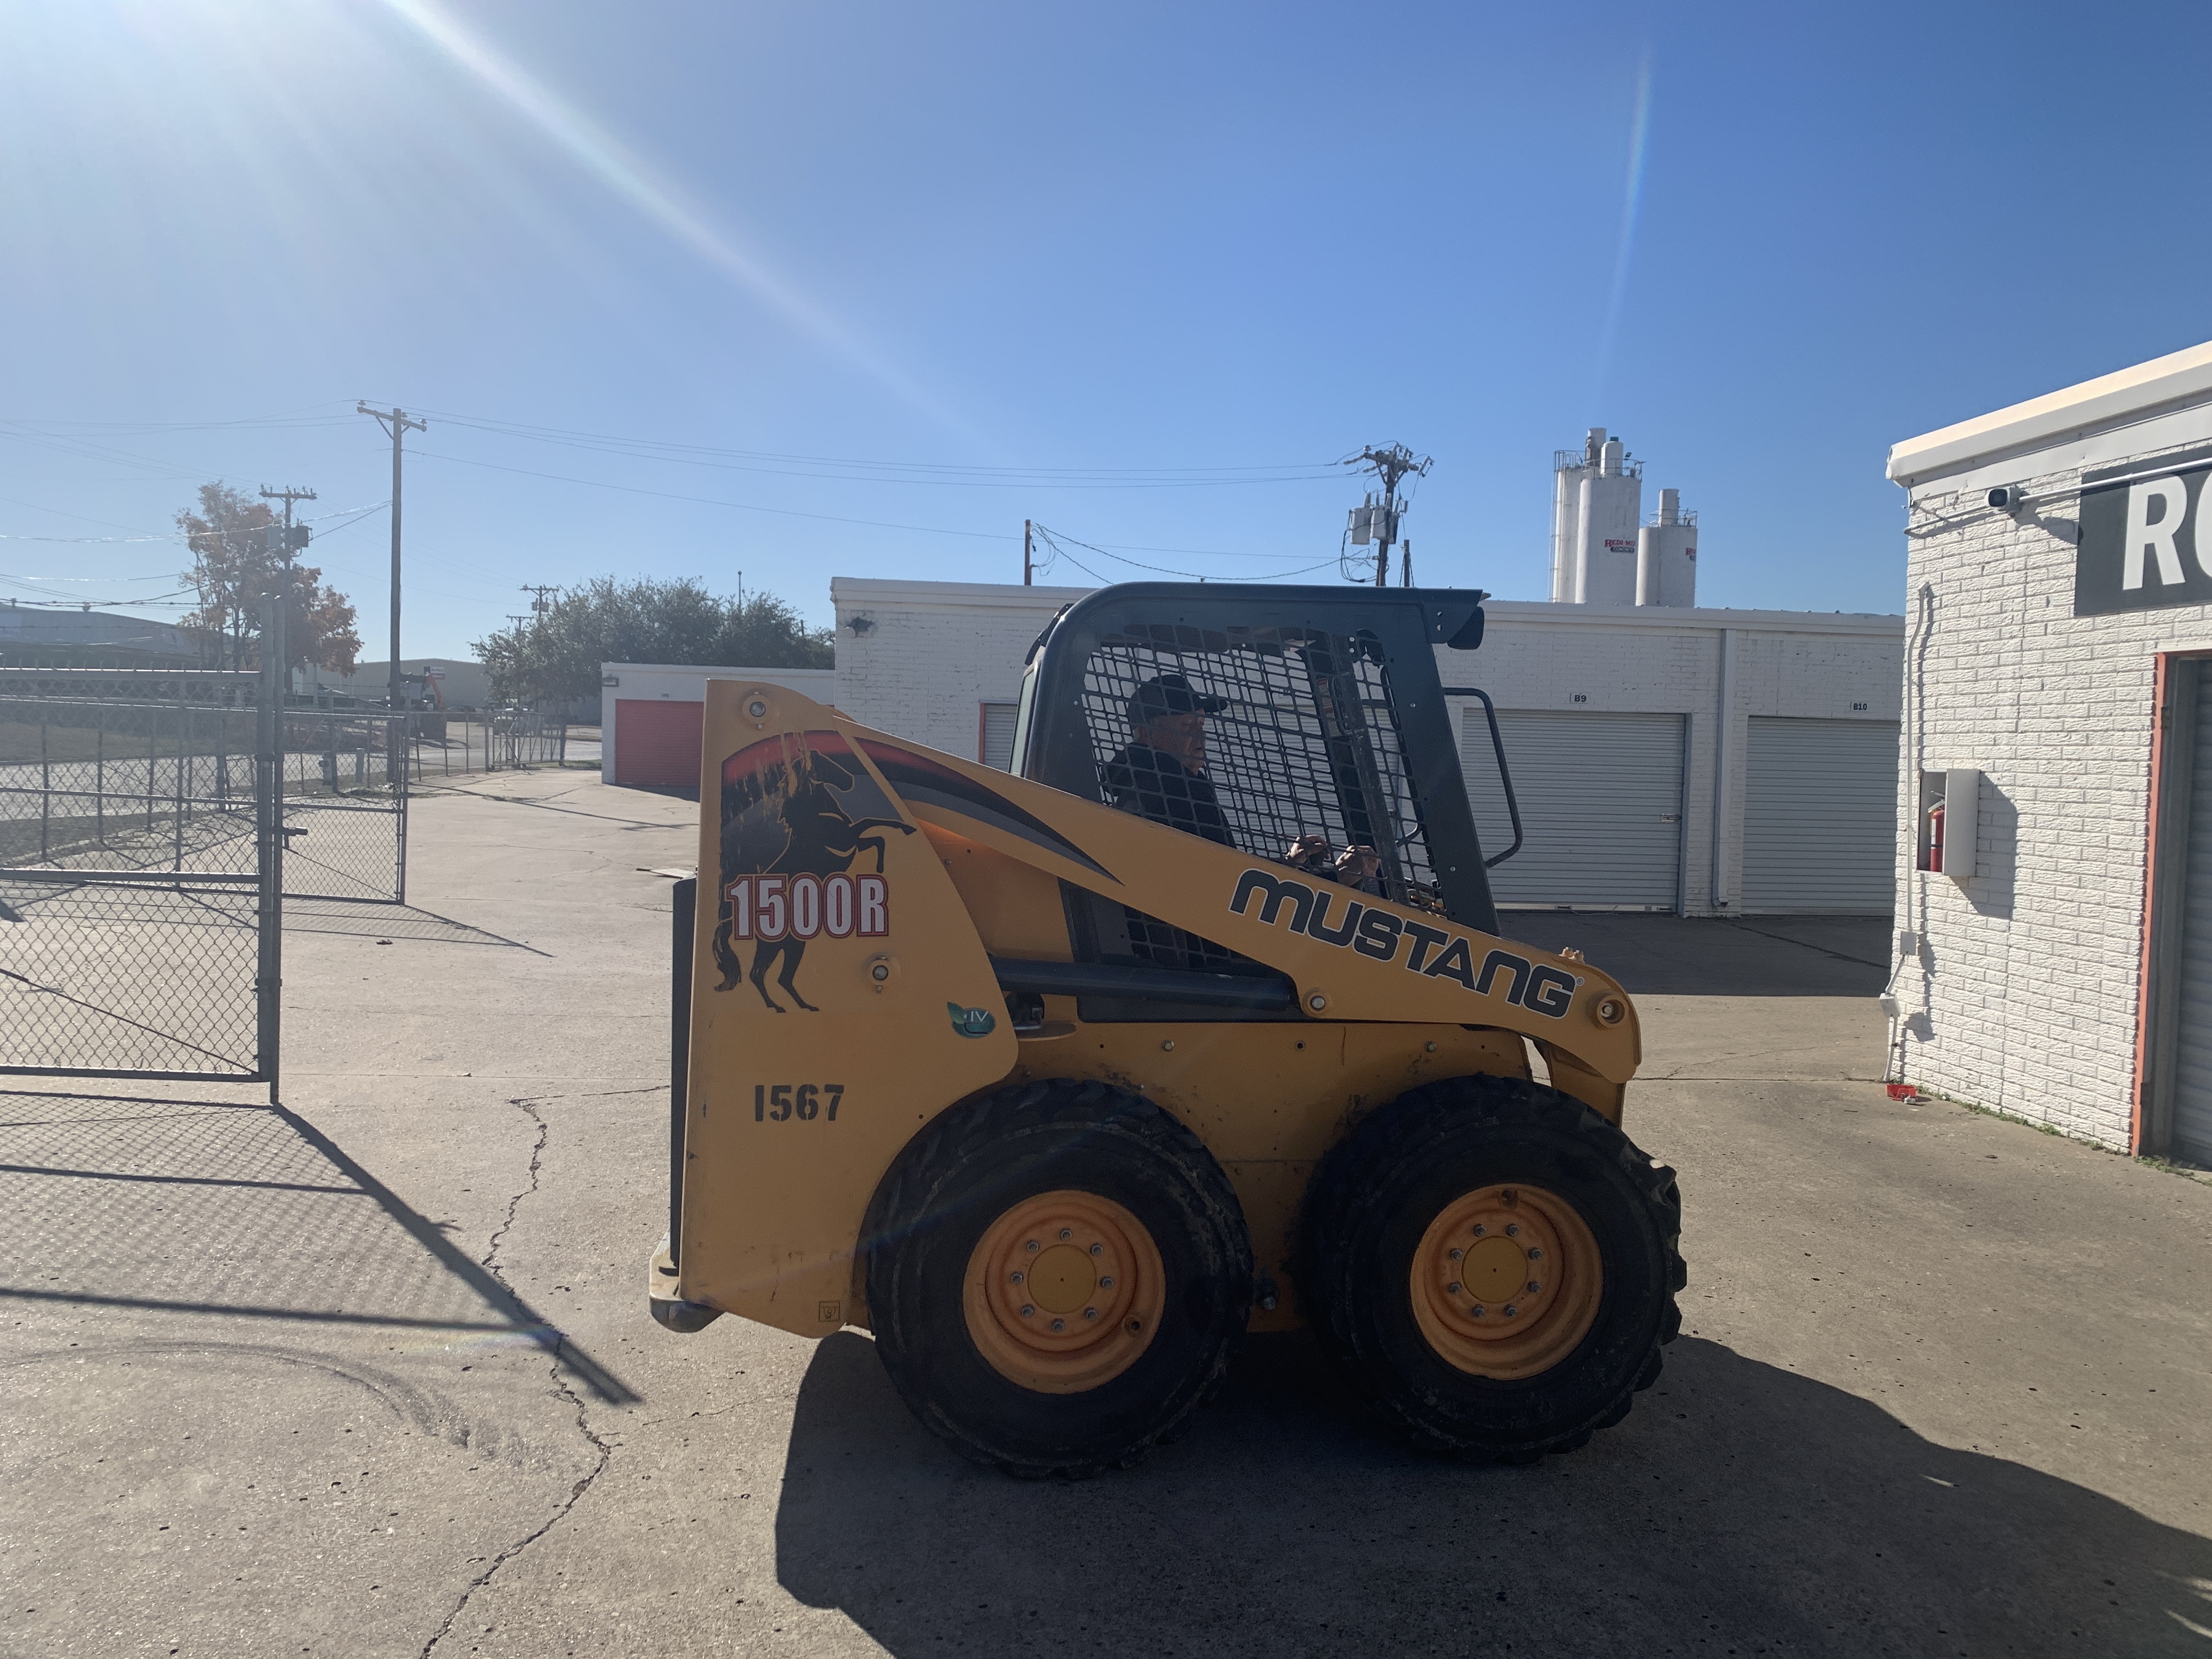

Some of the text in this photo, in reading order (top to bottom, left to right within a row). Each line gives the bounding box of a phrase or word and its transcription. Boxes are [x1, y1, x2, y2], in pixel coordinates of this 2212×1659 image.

[725, 872, 889, 941] 1500R
[1228, 868, 1578, 1019] MUSTANG
[755, 1084, 844, 1121] 1567
